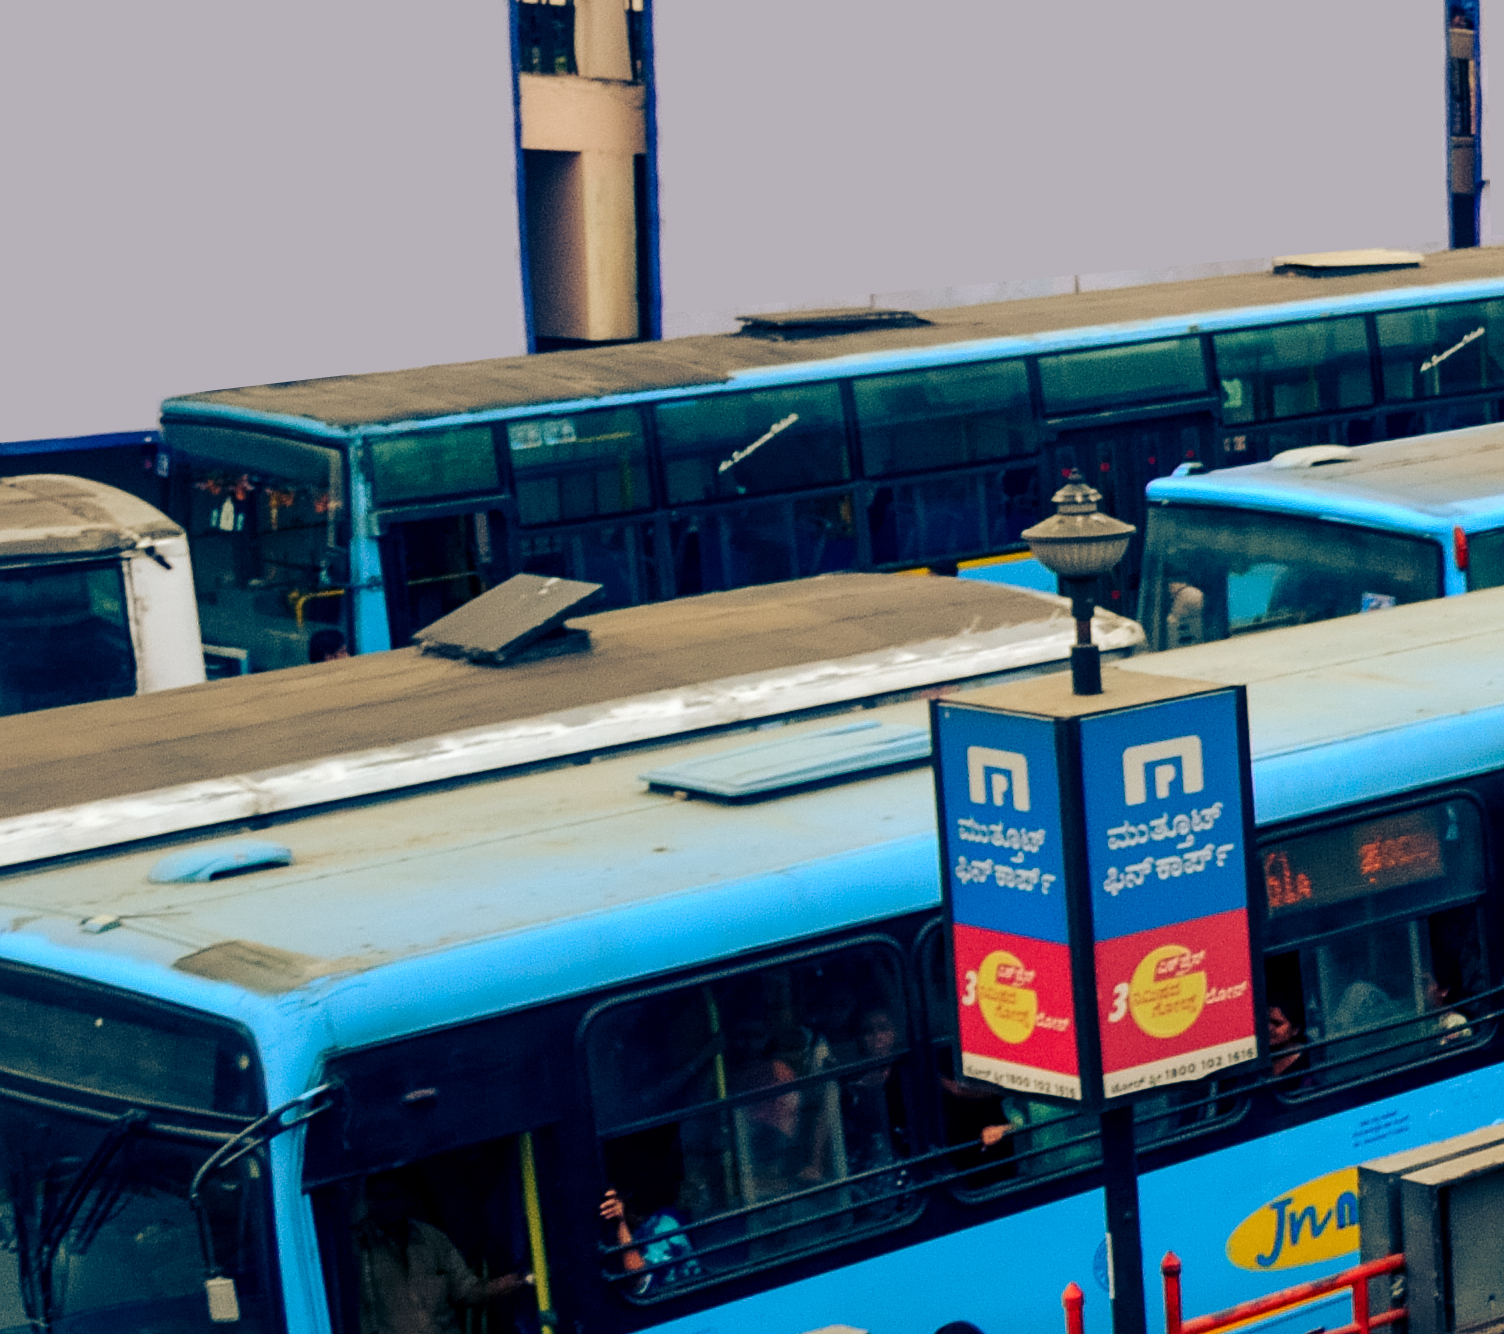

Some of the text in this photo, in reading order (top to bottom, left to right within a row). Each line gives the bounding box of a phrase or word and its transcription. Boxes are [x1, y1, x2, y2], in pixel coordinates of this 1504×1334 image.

[962, 970, 977, 1006] 3
[1108, 982, 1130, 1022] 3
[1165, 1062, 1198, 1082] 1800
[1201, 1055, 1224, 1072] 102
[1227, 1046, 1256, 1067] 1616
